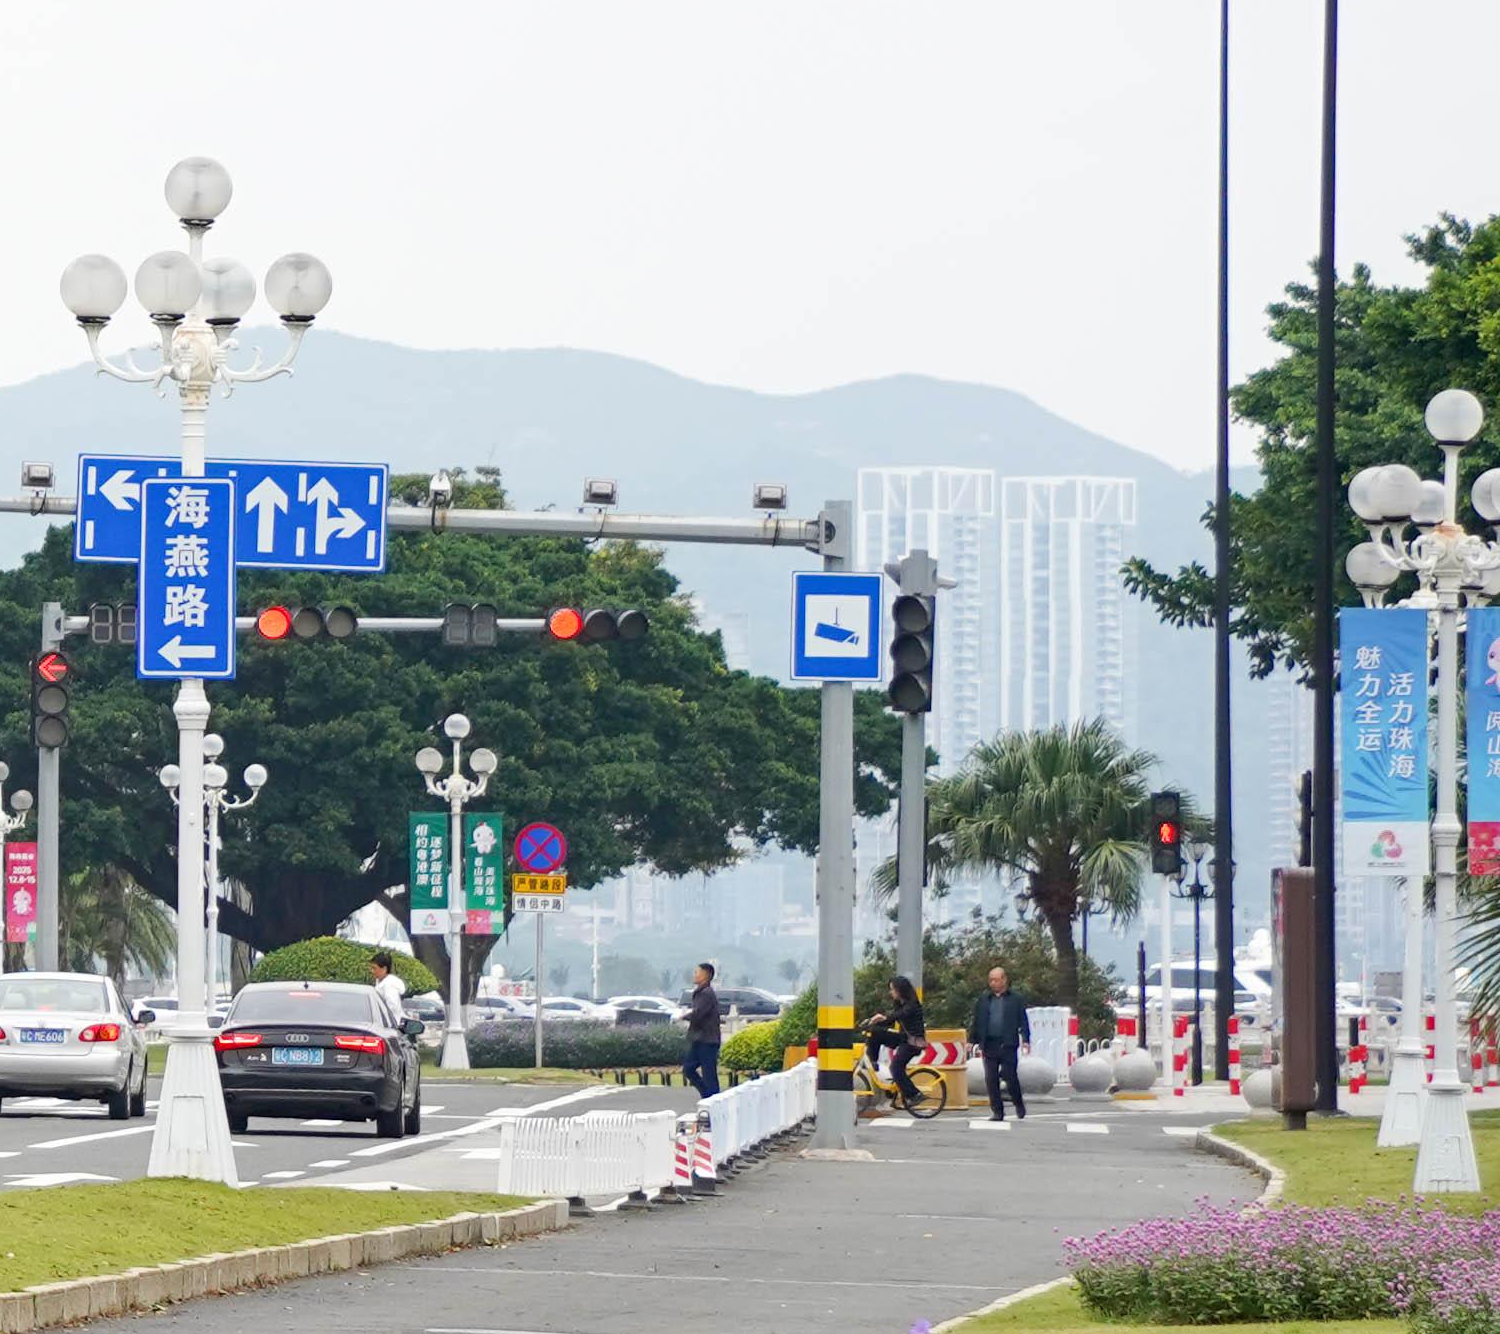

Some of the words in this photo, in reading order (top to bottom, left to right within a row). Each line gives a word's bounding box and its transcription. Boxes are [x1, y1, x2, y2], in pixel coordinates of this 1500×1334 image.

[163, 486, 210, 627] 海燕路
[1353, 645, 1382, 751] 魅力全运
[1386, 672, 1415, 779] 活力珠海
